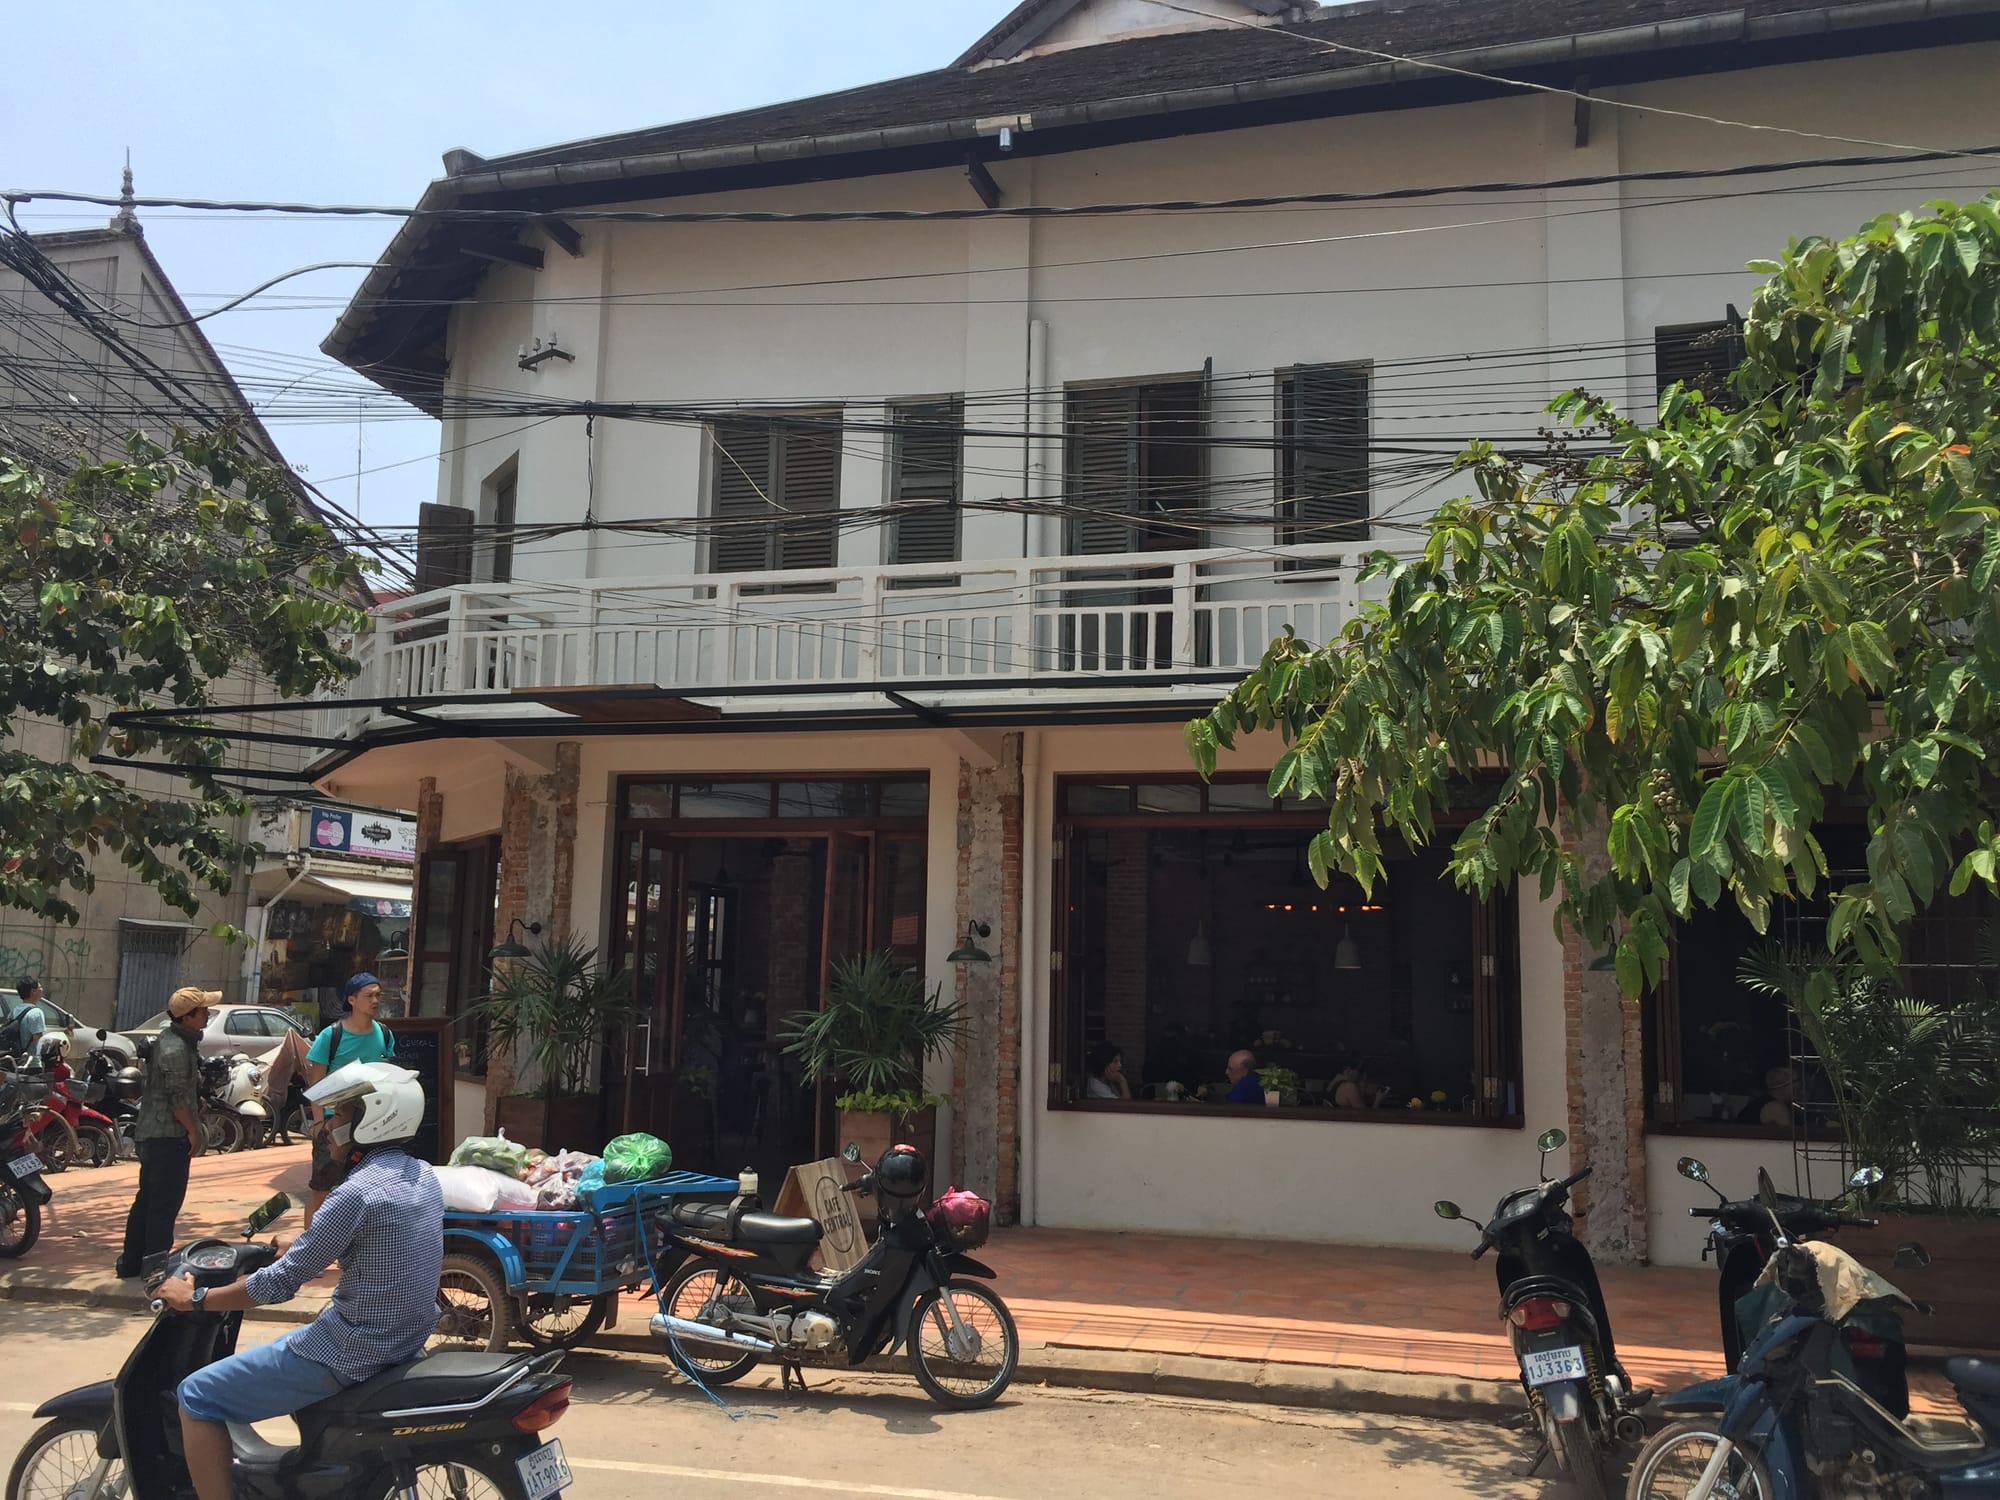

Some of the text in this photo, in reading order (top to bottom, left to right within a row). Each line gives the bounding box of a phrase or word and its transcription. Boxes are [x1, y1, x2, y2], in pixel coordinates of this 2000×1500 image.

[823, 1196, 842, 1214] CAFE
[823, 1212, 852, 1234] CENTRAL
[391, 1421, 468, 1437] Dream
